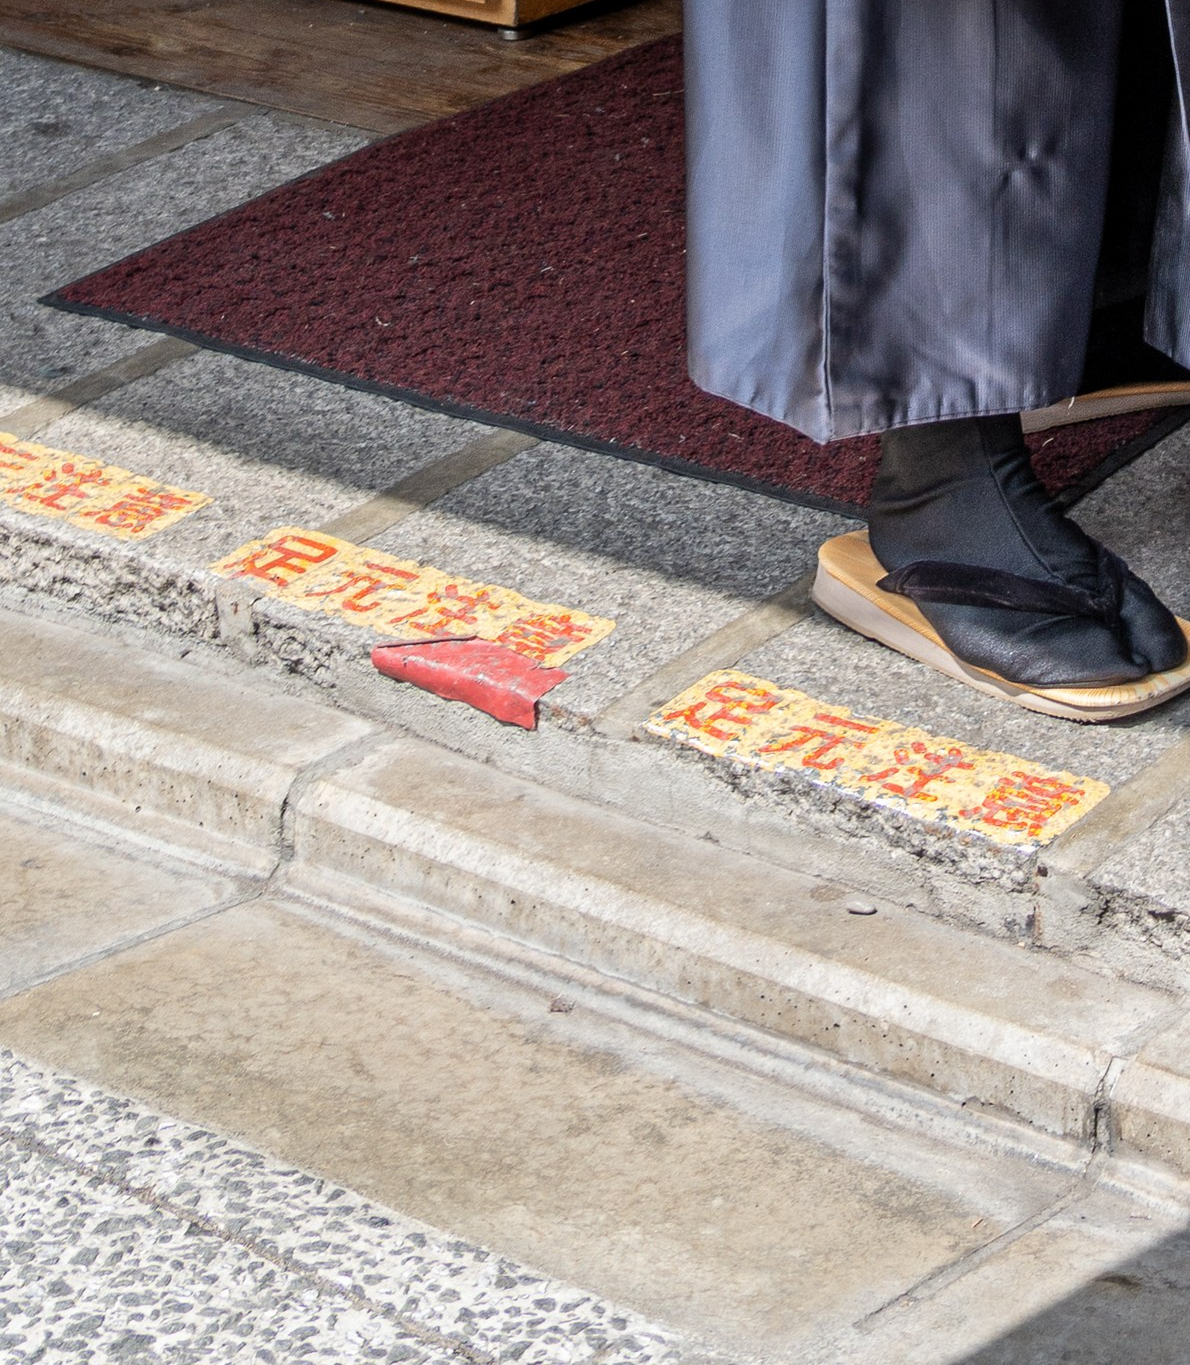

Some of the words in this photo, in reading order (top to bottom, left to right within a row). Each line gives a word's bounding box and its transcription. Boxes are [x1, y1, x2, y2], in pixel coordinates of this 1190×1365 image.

[223, 534, 592, 660] 足元注意
[663, 680, 1085, 837] 足元注意
